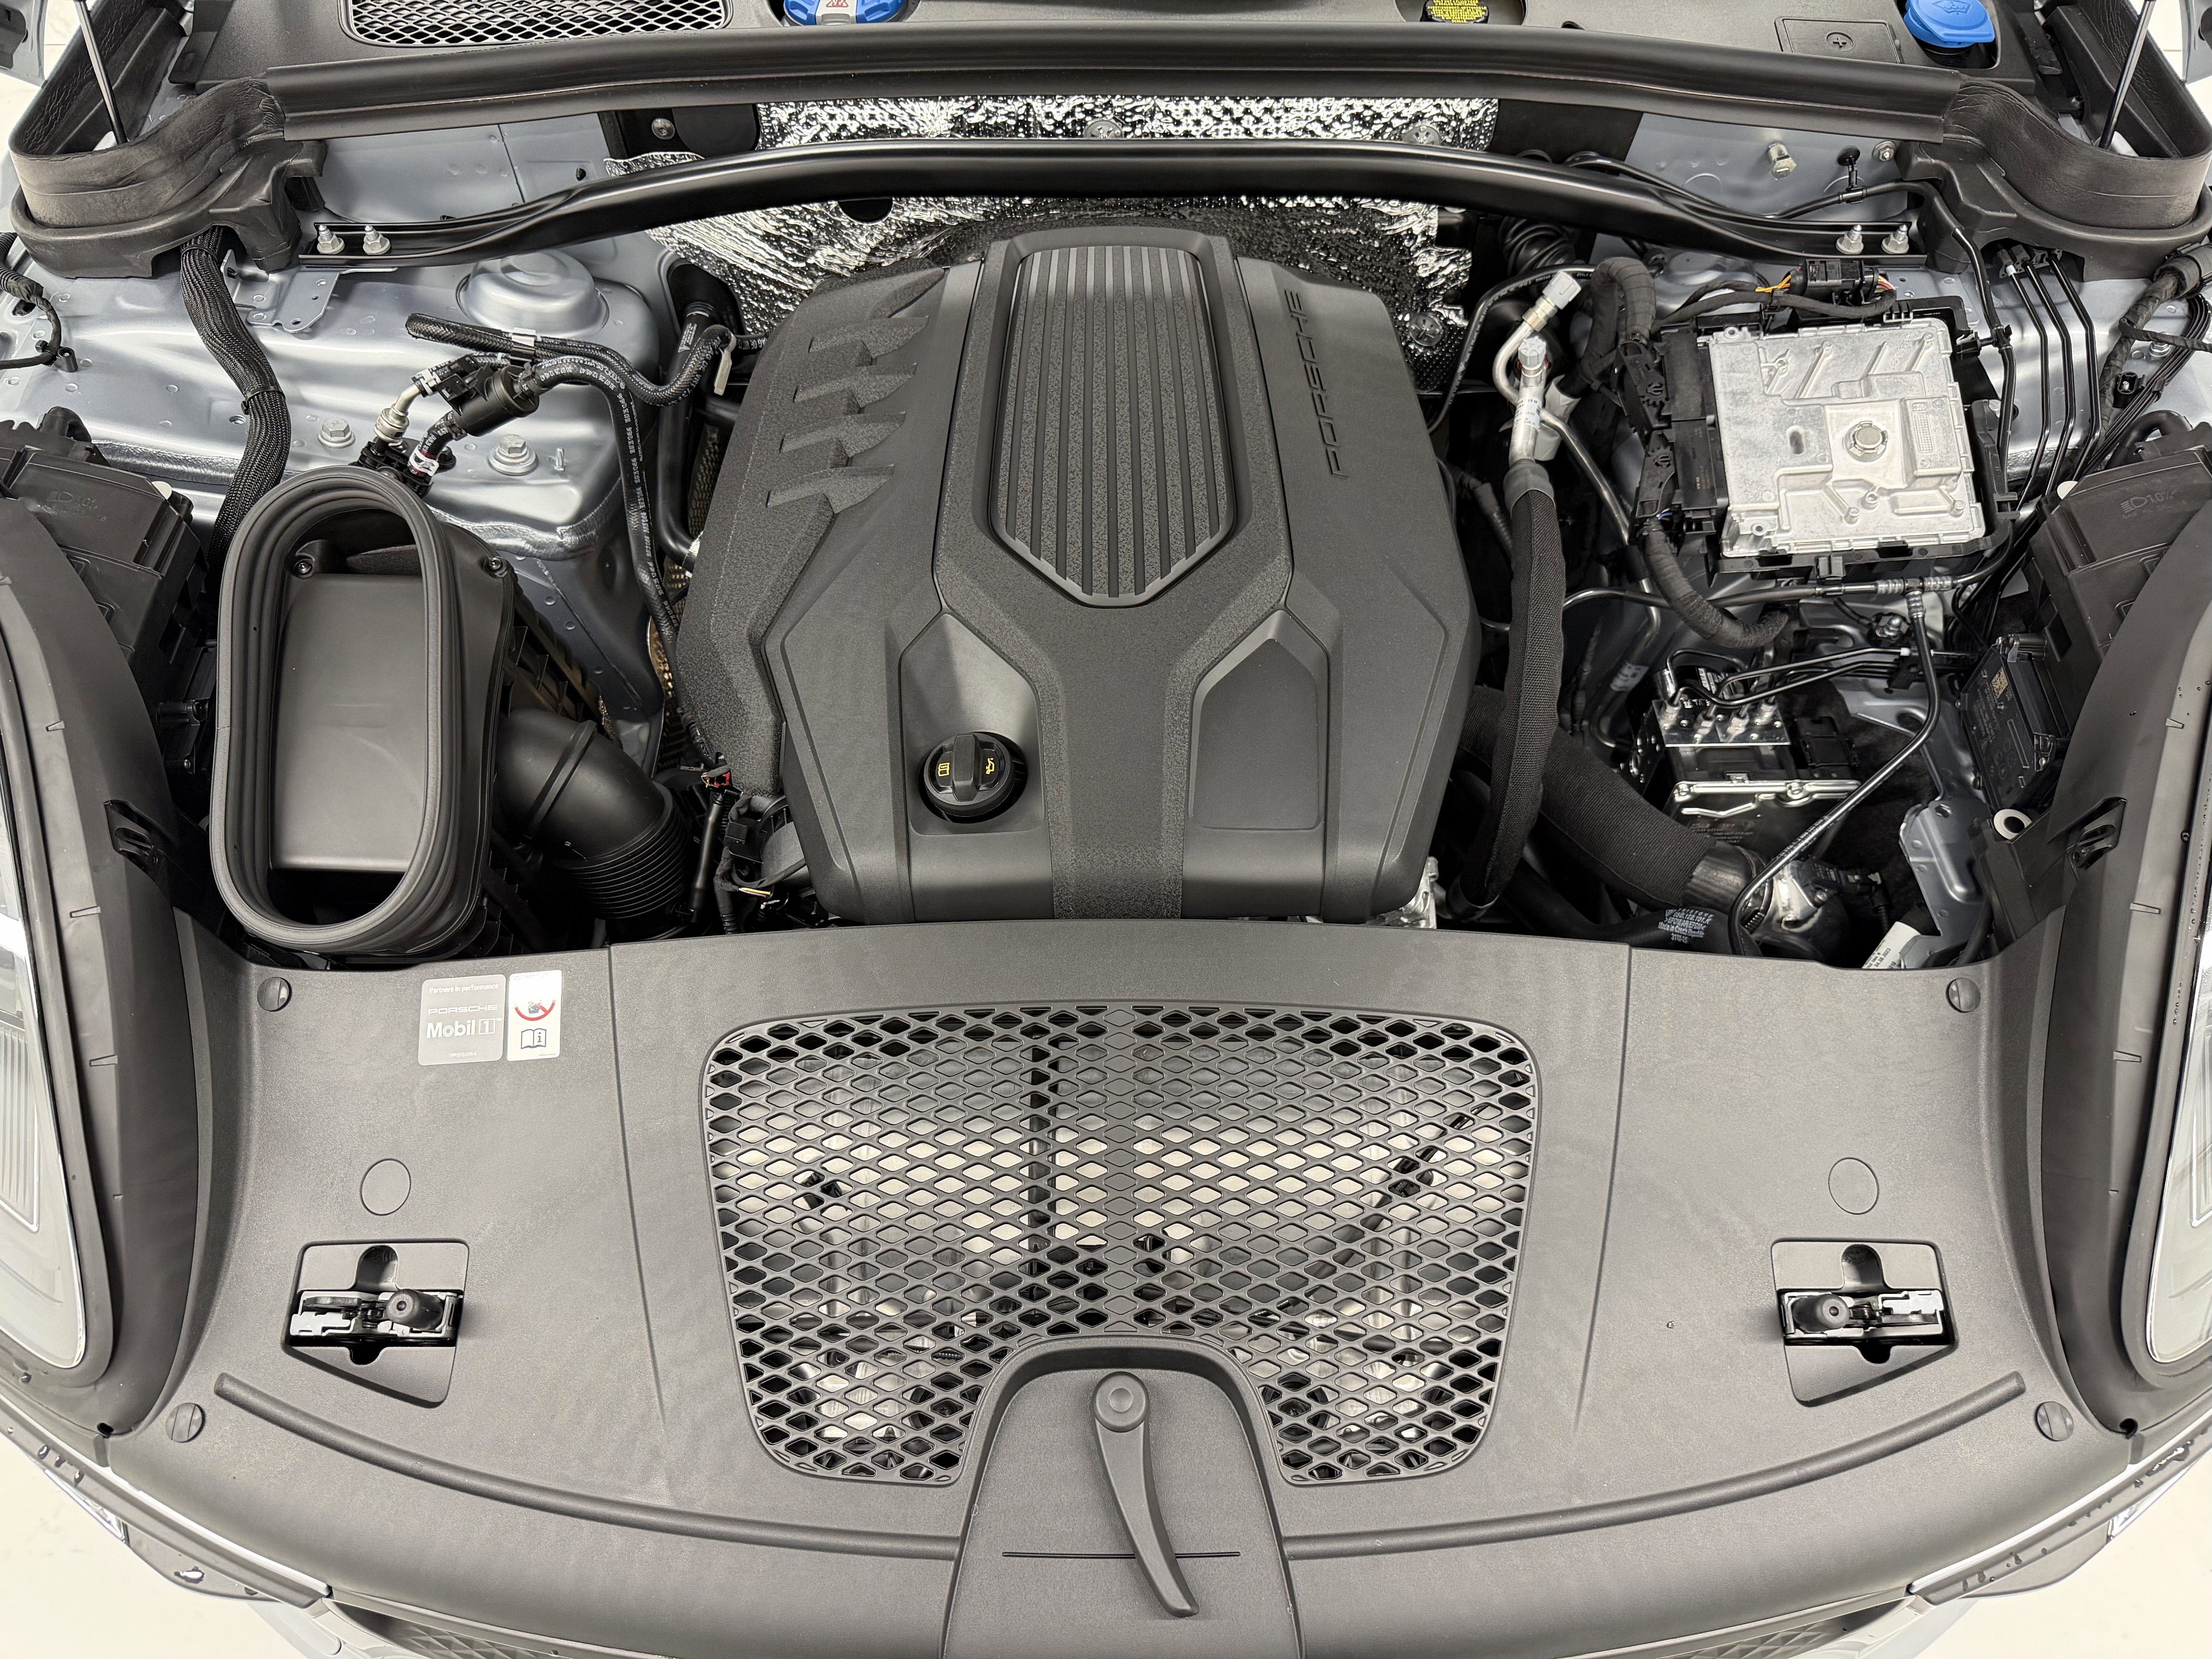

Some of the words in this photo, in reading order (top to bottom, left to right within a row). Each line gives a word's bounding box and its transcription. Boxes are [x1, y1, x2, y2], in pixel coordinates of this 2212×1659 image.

[1284, 289, 1348, 478] PORSCHE
[461, 984, 499, 993] performance
[428, 1004, 498, 1015] PORSCHE
[427, 1019, 476, 1038] Mobil
